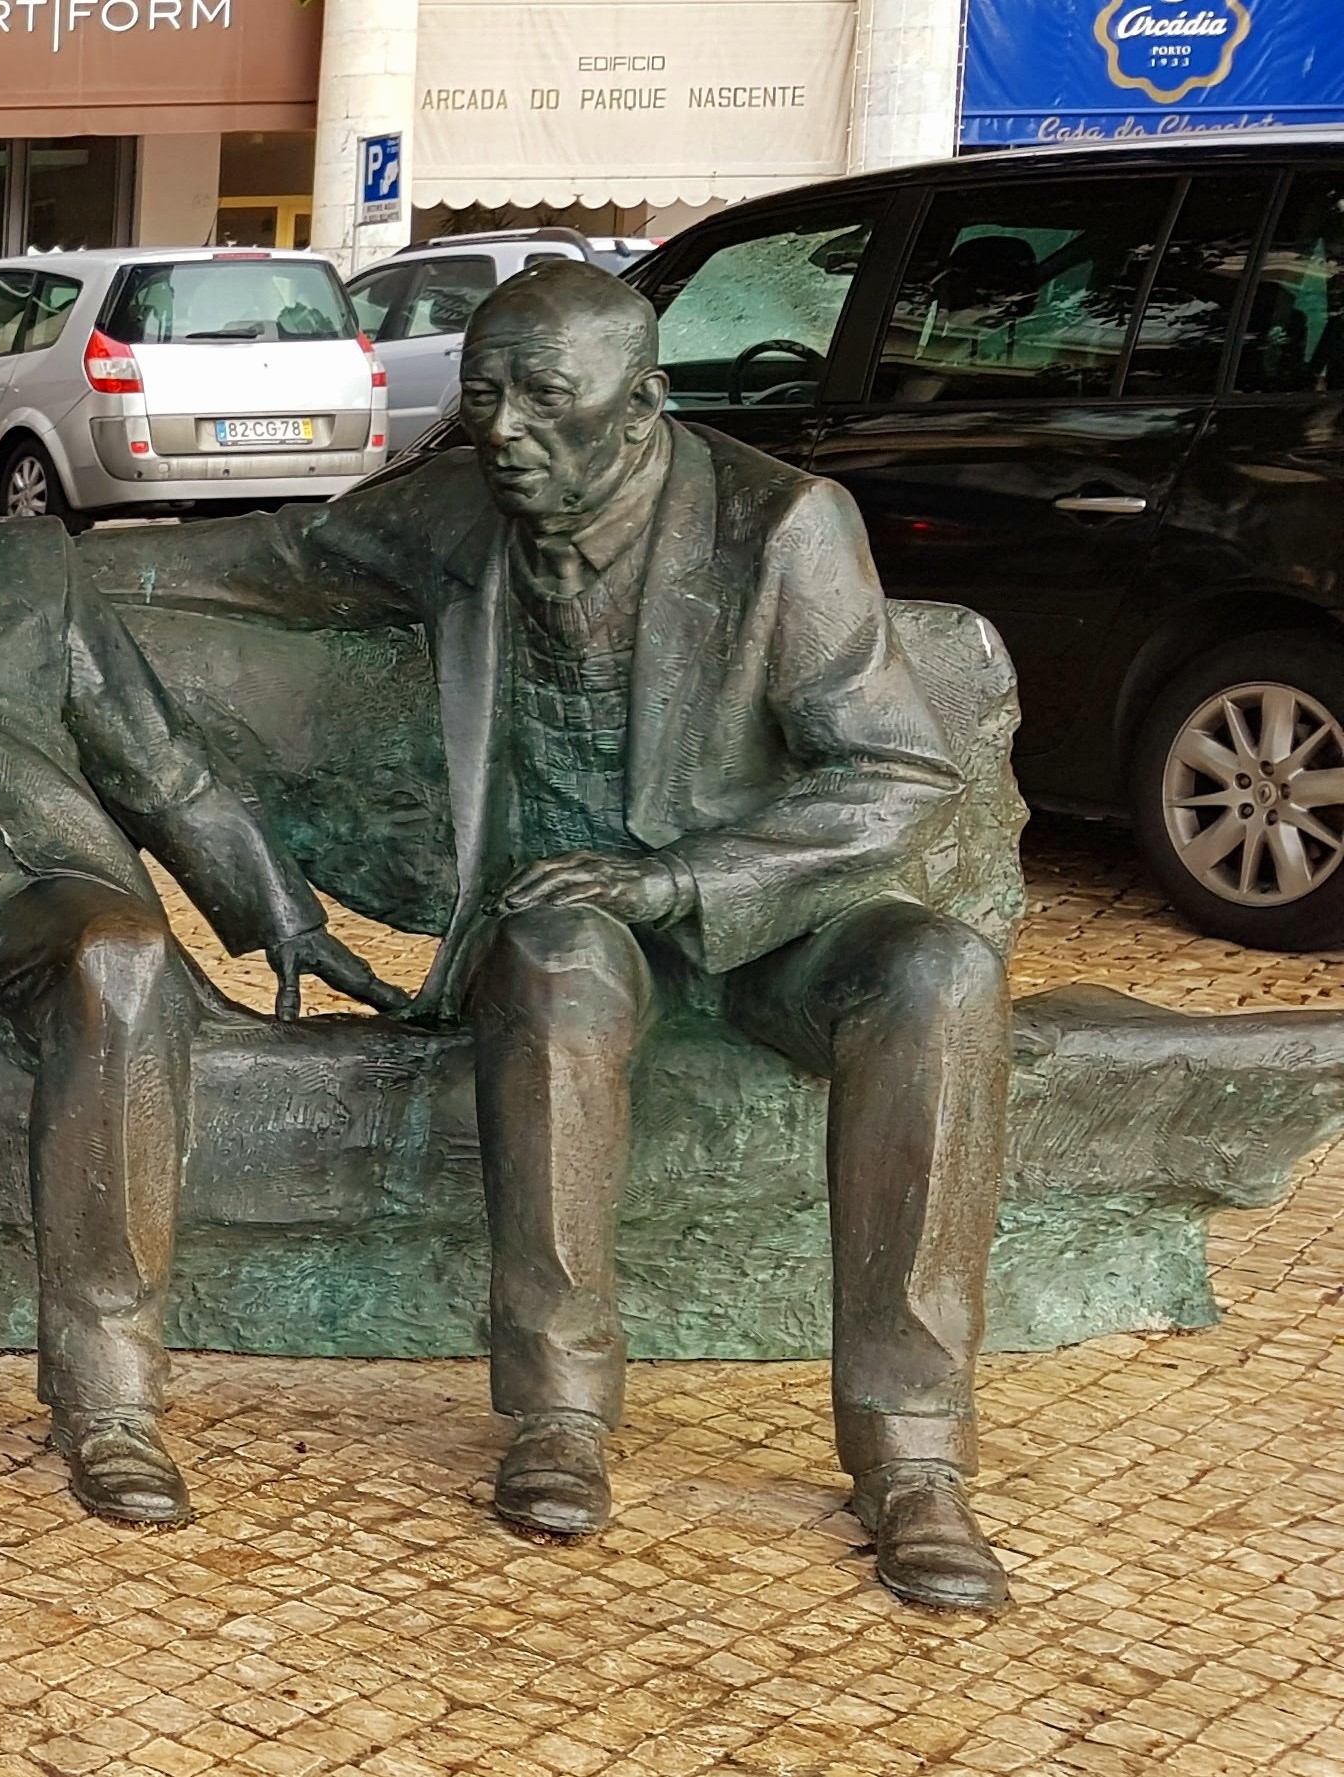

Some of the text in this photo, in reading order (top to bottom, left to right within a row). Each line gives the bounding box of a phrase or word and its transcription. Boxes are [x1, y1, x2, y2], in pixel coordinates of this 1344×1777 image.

[1116, 6, 1227, 40] Arcádia
[578, 55, 666, 72] EDIFICIO
[1150, 57, 1191, 68] 1933
[1152, 46, 1192, 56] PORTO
[421, 85, 806, 112] ARCADA DO PARQUE NASCENTE
[1038, 115, 1106, 141] Casa
[367, 144, 384, 186] P
